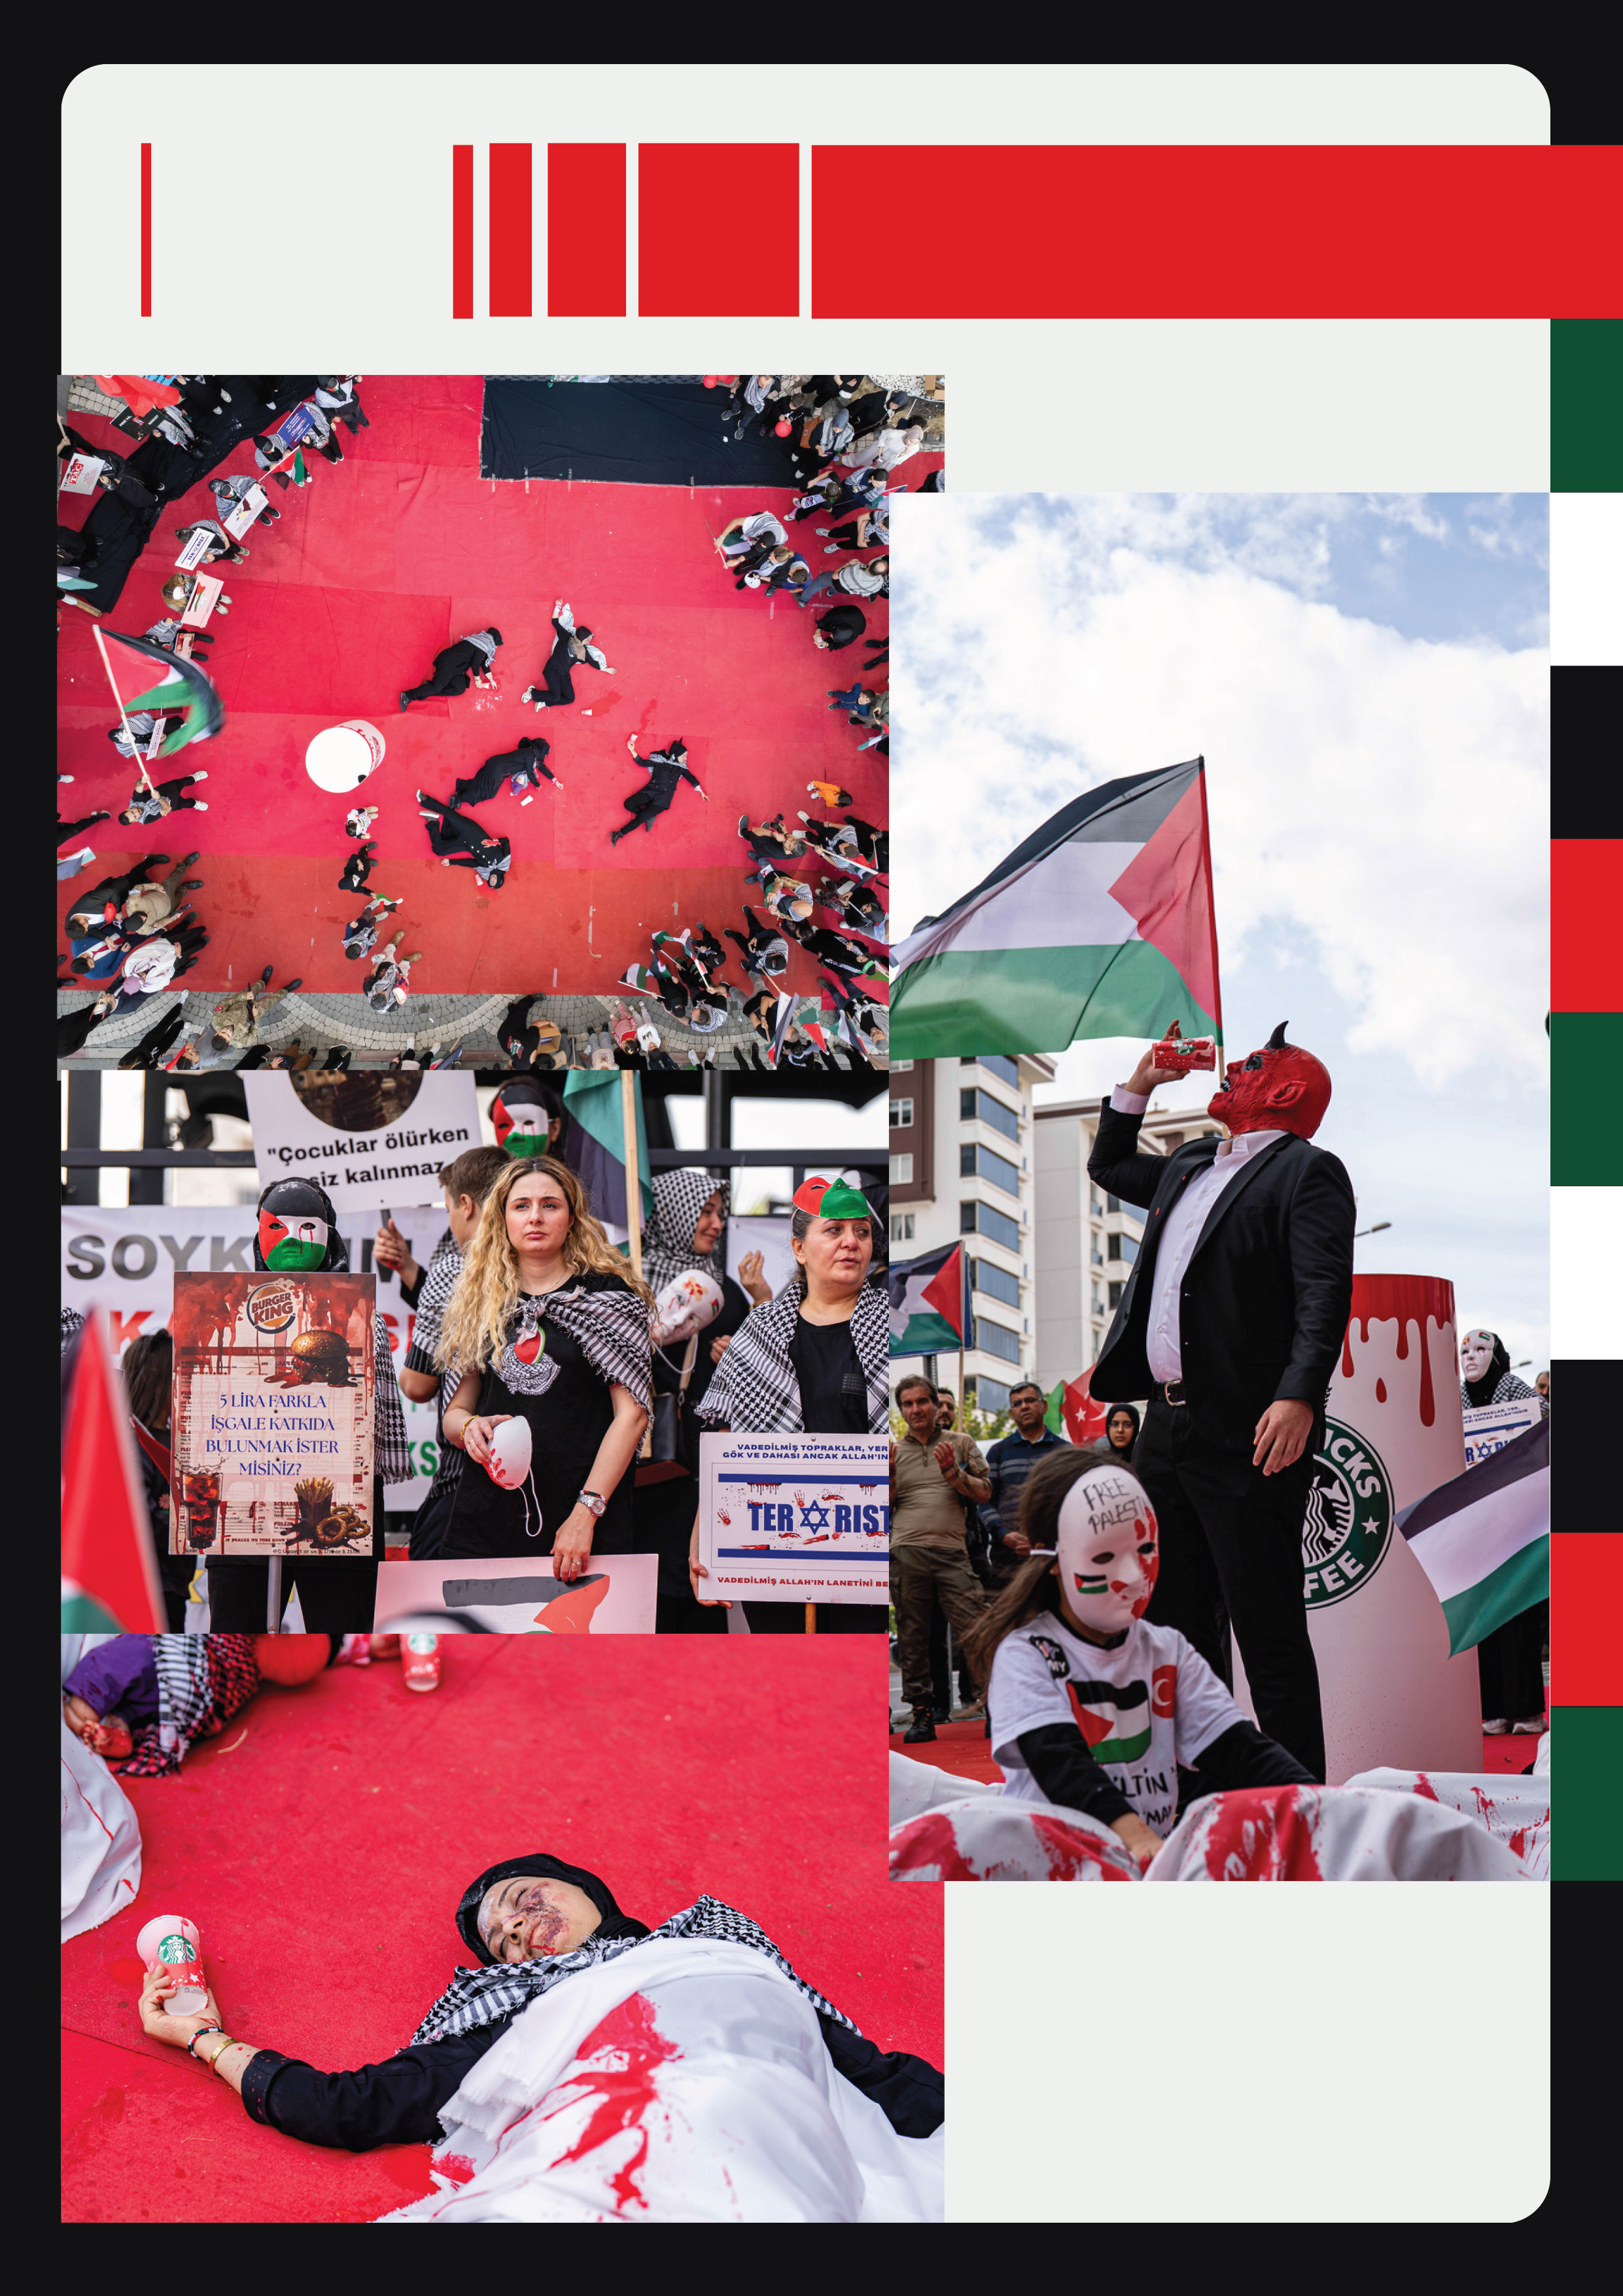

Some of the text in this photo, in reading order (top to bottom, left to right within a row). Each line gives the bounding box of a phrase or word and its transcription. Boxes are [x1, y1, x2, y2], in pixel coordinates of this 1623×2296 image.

[268, 1128, 469, 1166] "Çocuklar ölürken
[252, 1292, 292, 1313] BURGER
[253, 1301, 293, 1327] KING
[220, 1392, 327, 1409] 5 LİRA FARKLA
[211, 1414, 335, 1433] İŞGALE KATKIDA
[206, 1438, 339, 1453] BULUNMAK İSTER
[723, 1450, 744, 1458] GÖK
[737, 1442, 798, 1453] VADEDİLMİŞ
[239, 1460, 302, 1475] MİSİNİZ?
[1083, 1478, 1129, 1511] FREE
[717, 1576, 777, 1586] VADEDİLMİŞ
